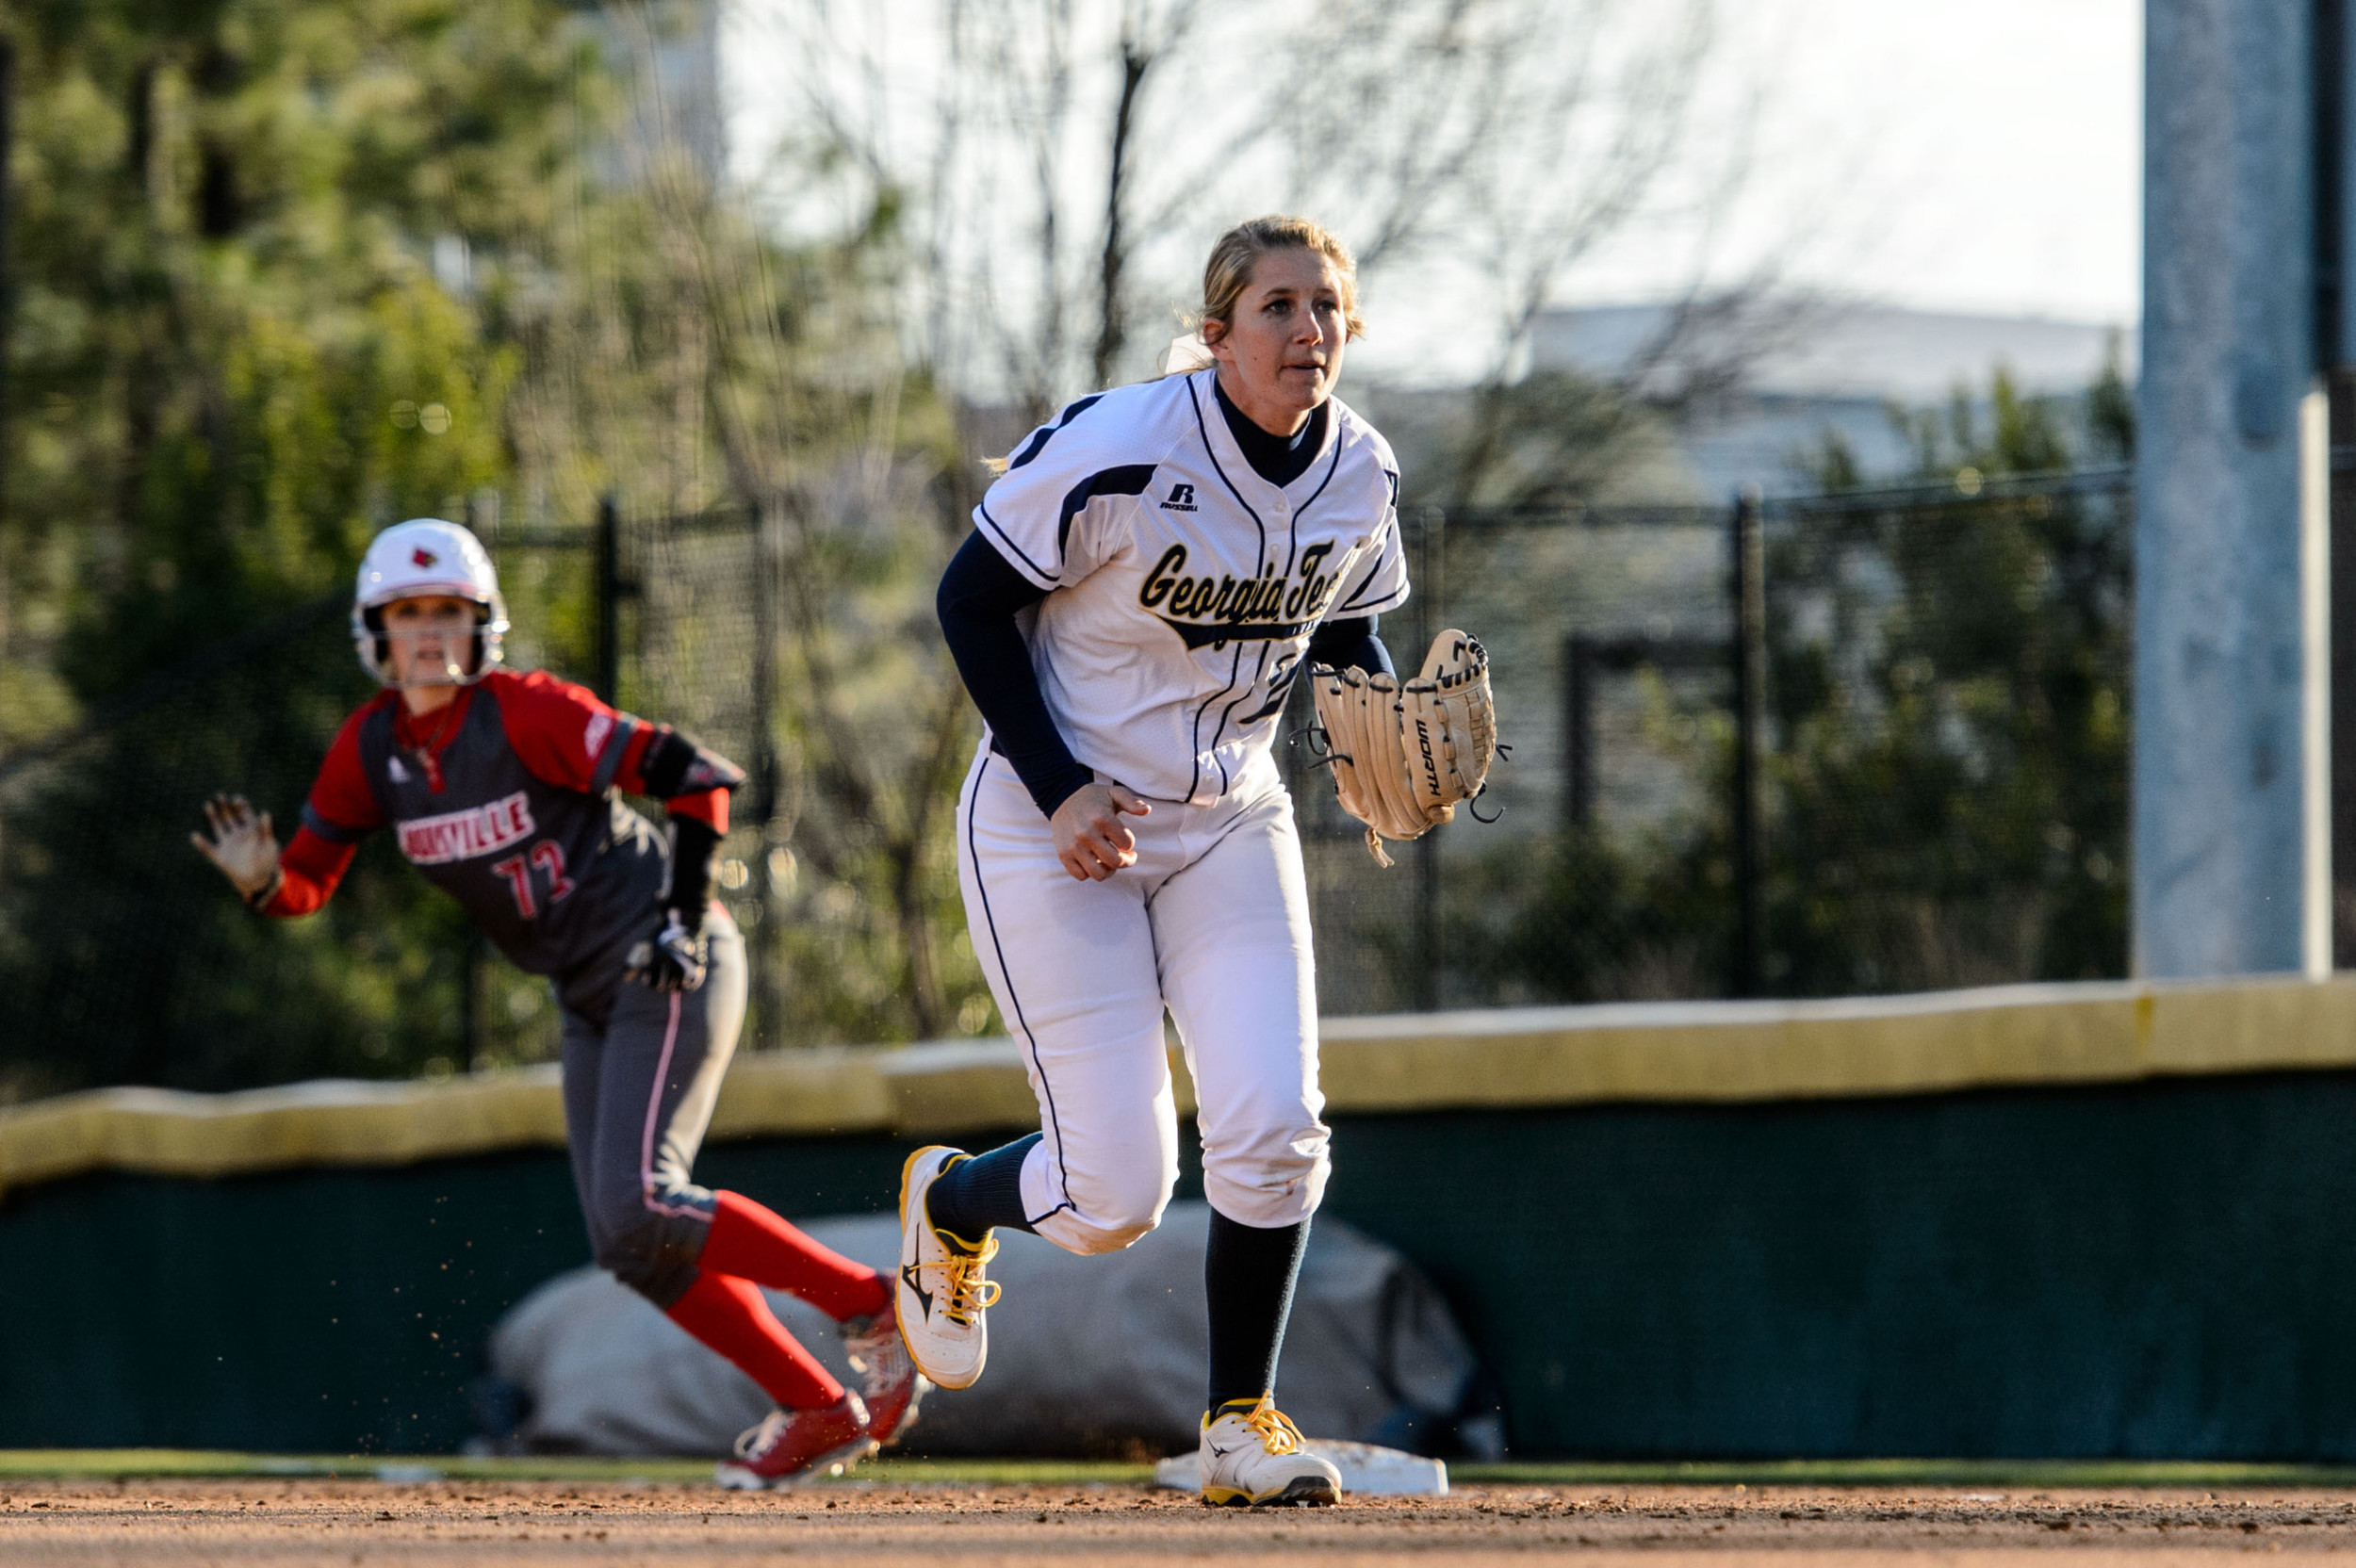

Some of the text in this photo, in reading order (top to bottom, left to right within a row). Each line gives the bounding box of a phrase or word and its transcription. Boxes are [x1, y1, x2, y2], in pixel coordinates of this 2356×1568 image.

[1159, 501, 1198, 512] RUSSELL
[1168, 483, 1194, 504] R
[1138, 544, 1284, 649] Georgia
[1415, 718, 1441, 796] WORTH
